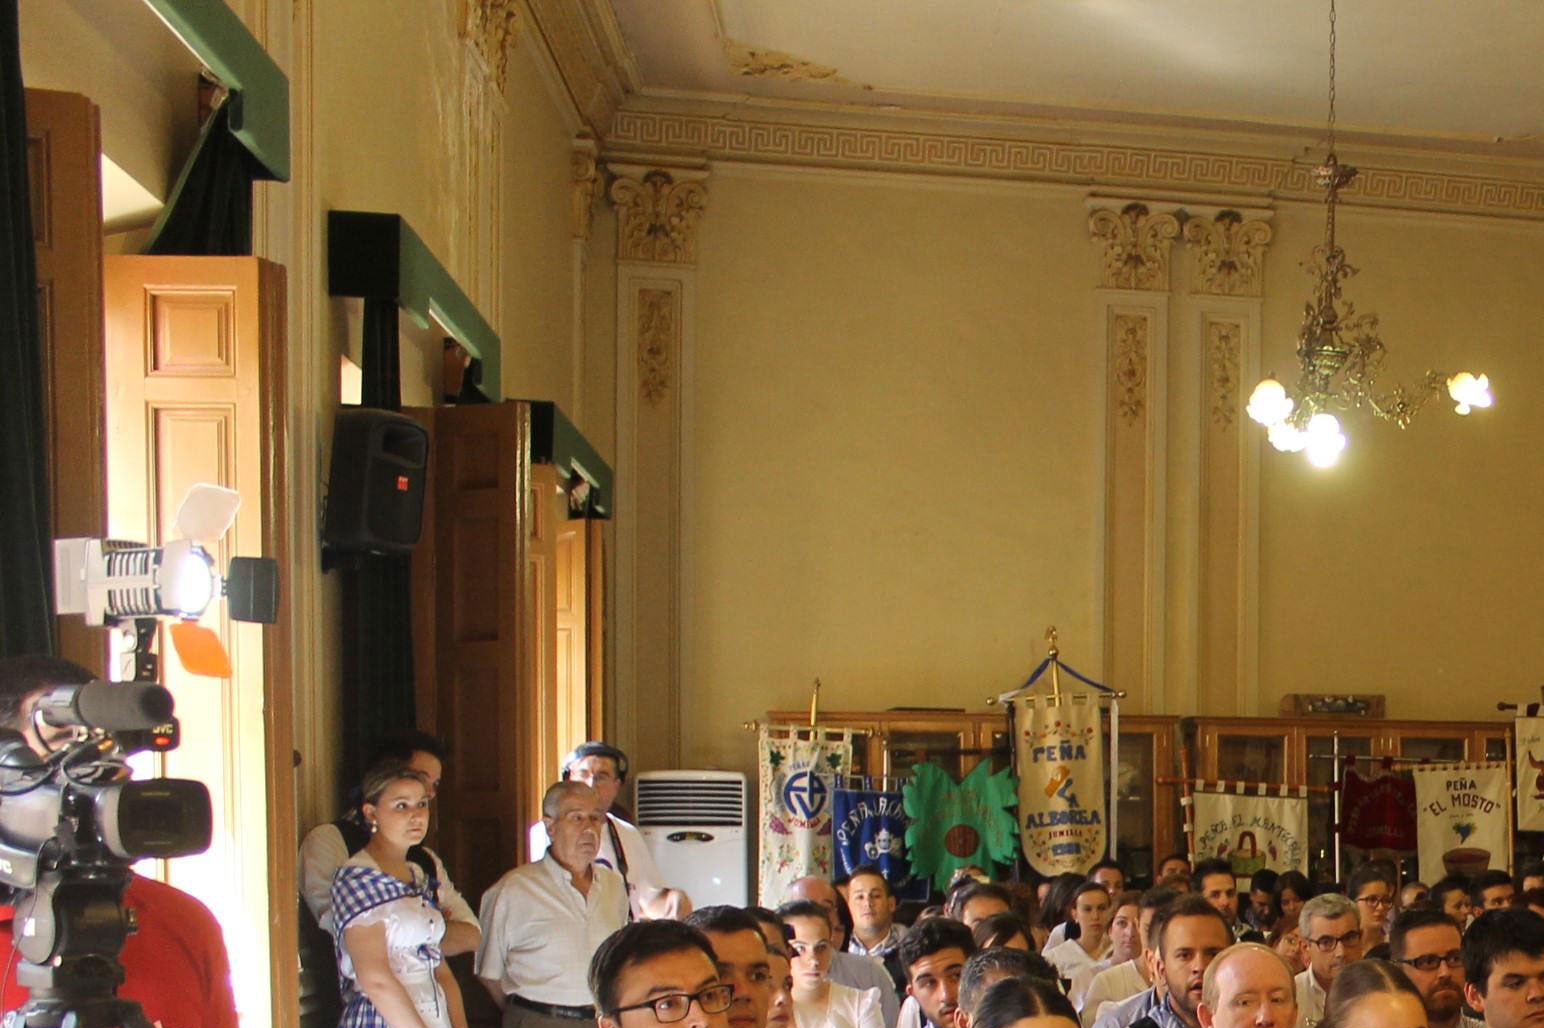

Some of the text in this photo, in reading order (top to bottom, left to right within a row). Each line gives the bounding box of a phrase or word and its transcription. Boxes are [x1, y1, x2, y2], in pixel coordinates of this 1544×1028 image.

[152, 723, 174, 735] JVC
[1032, 740, 1087, 763] PEÑA
[1446, 777, 1477, 792] PEÑA
